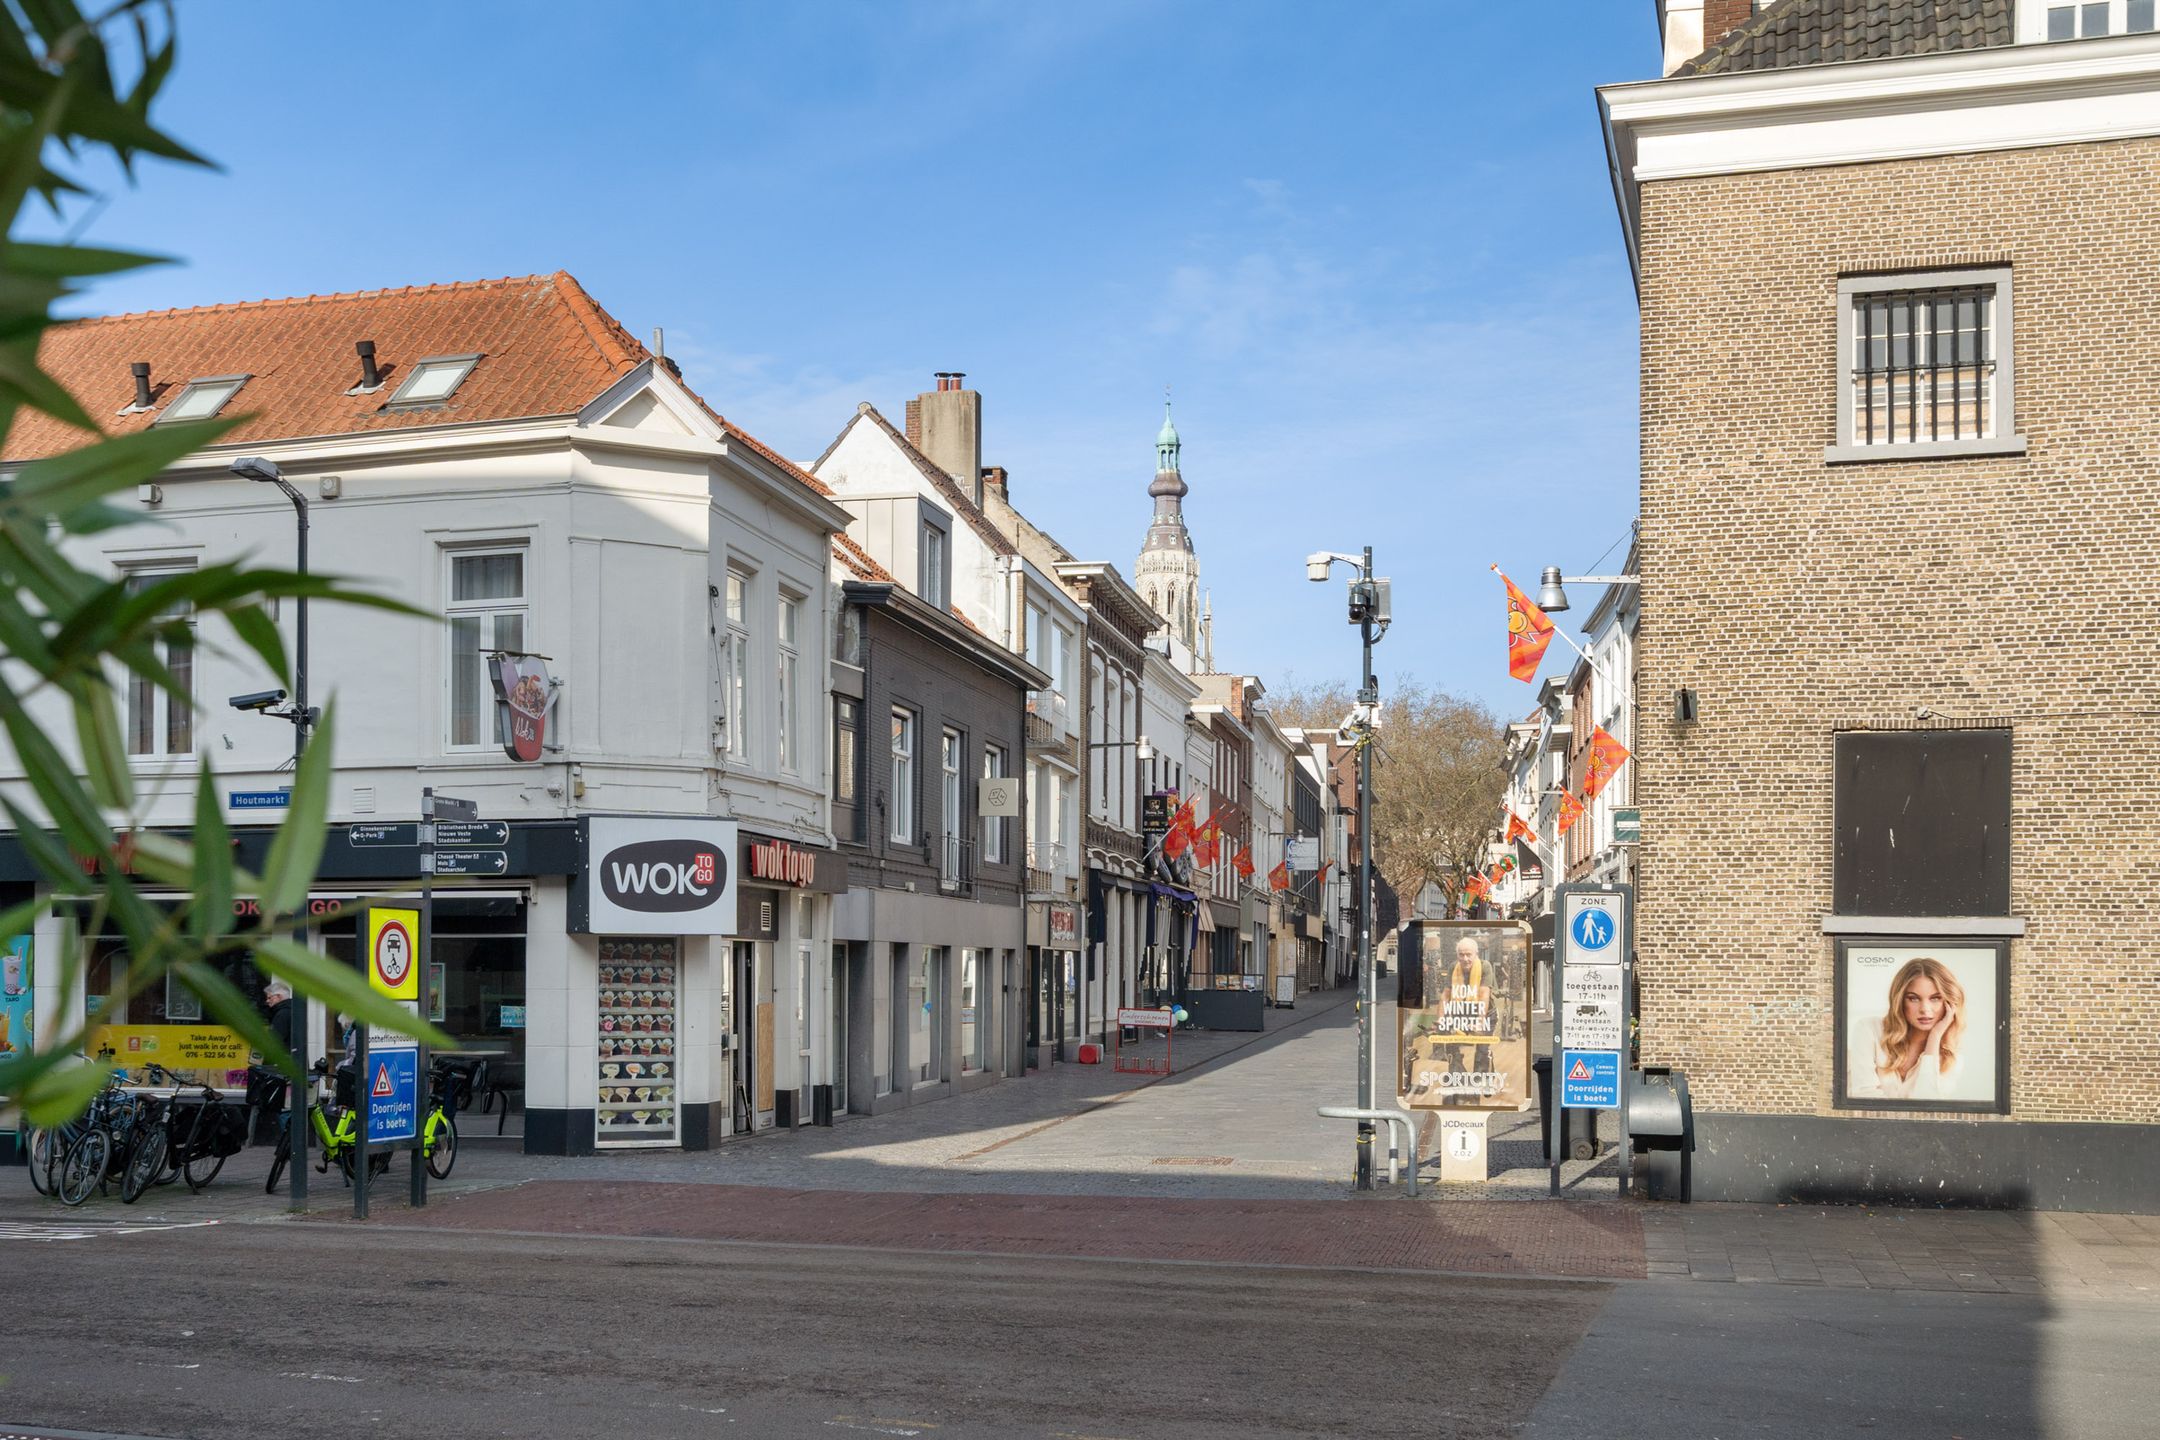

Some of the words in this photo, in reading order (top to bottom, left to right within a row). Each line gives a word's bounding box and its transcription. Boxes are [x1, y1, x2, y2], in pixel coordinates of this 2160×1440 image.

[236, 796, 284, 804] Houtmarkt
[697, 855, 712, 868] TO
[755, 841, 784, 880] wok
[786, 844, 798, 882] to
[799, 851, 815, 888] go
[611, 862, 707, 897] WOK
[697, 869, 712, 882] GO
[311, 899, 341, 915] GO
[1857, 956, 1895, 964] COSMO
[1452, 984, 1478, 999] KOM
[1566, 983, 1619, 991] toegestaan
[1443, 1001, 1486, 1015] WINTER
[1438, 1016, 1491, 1031] SPORTEN
[208, 1034, 231, 1042] Away?
[1420, 1071, 1508, 1091] SPORTCITY
[1568, 1085, 1614, 1094] Doorrijden
[372, 1102, 411, 1116] Doorrijden
[377, 1119, 384, 1129] is
[386, 1118, 407, 1129] boete
[1443, 1120, 1485, 1128] JCDecaux
